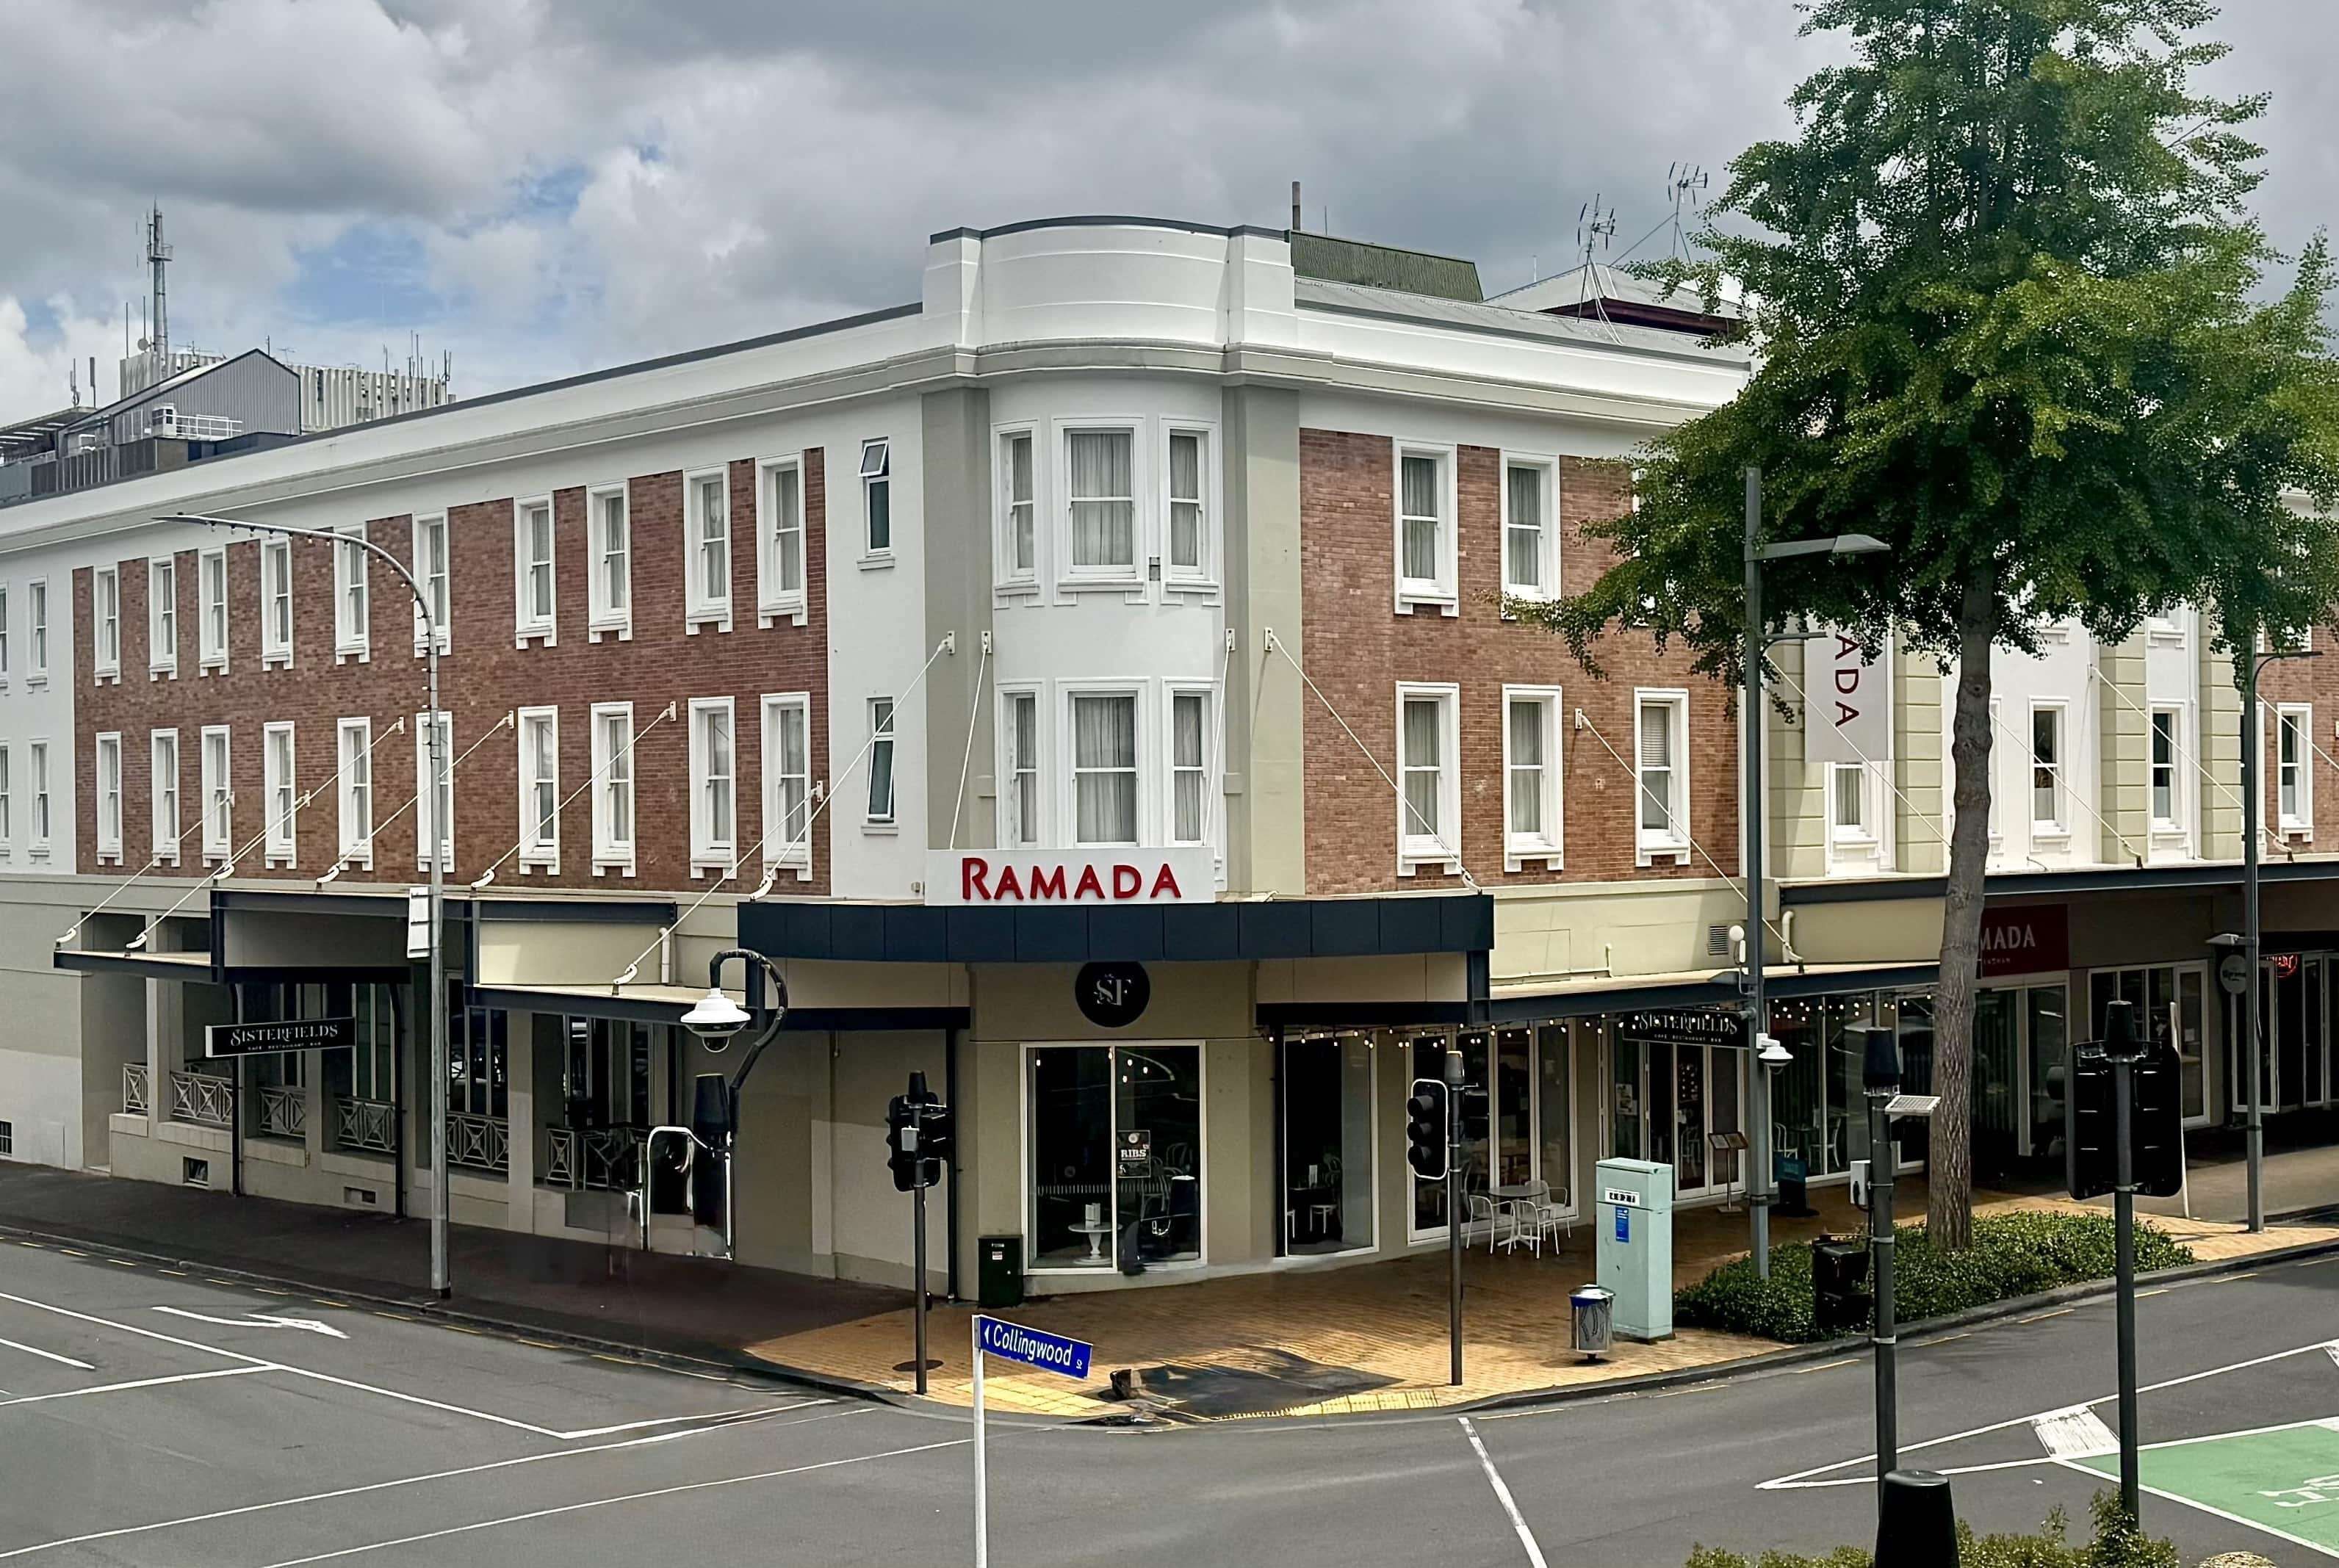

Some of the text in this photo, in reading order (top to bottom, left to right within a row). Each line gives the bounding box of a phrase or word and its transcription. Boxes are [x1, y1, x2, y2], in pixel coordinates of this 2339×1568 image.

[1835, 634, 1860, 727] ADA
[962, 857, 1182, 900] RAMADA
[1981, 924, 2036, 950] MADA
[231, 1025, 338, 1046] SISTERFIELDS
[1639, 1011, 1737, 1034] SISTERFIELDS
[1121, 1149, 1146, 1157] RIBS
[993, 1324, 1073, 1366] Collingwood
